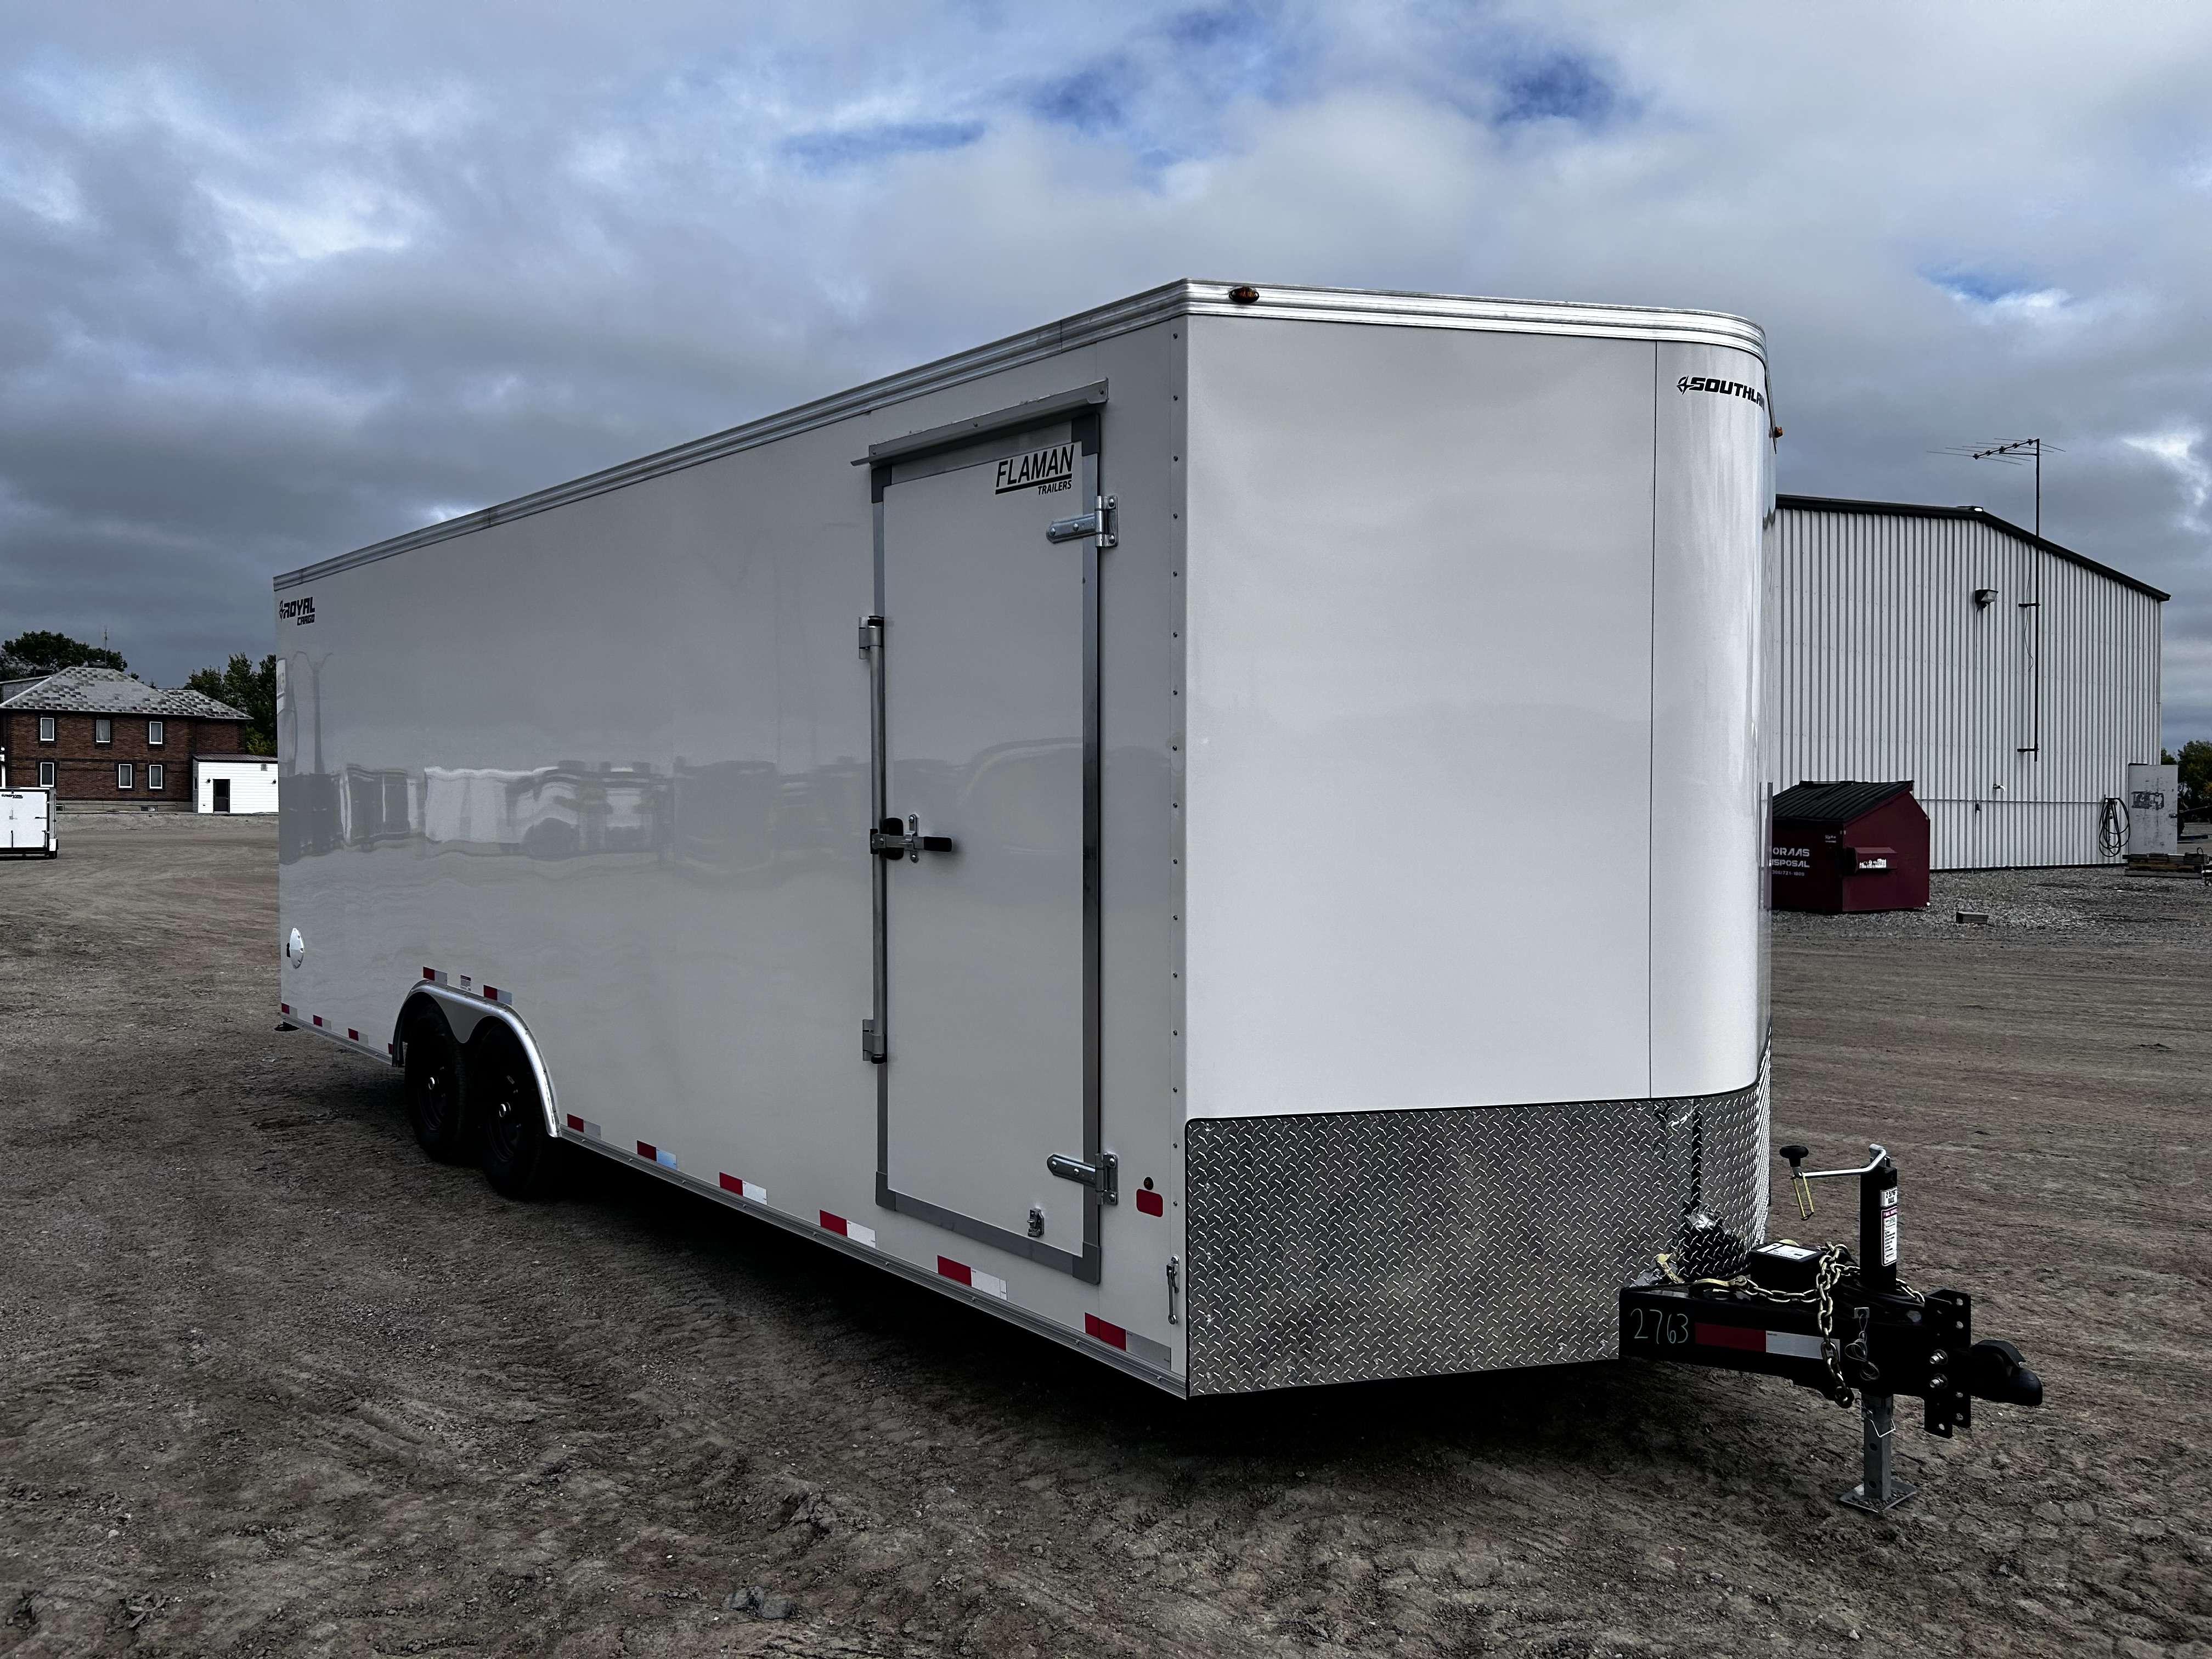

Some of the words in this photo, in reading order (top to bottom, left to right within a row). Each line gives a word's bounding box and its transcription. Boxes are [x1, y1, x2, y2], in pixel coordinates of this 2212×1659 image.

[1689, 377, 1765, 410] SOUTHLAN
[996, 444, 1075, 488] FLAMAN
[1037, 479, 1073, 495] TRAILERS
[283, 596, 315, 619] ROYAL
[297, 614, 315, 625] CARGO
[1772, 847, 1810, 857] ORAAS
[1771, 859, 1810, 868] ISPOSAL
[1630, 1308, 1689, 1345] 2763
